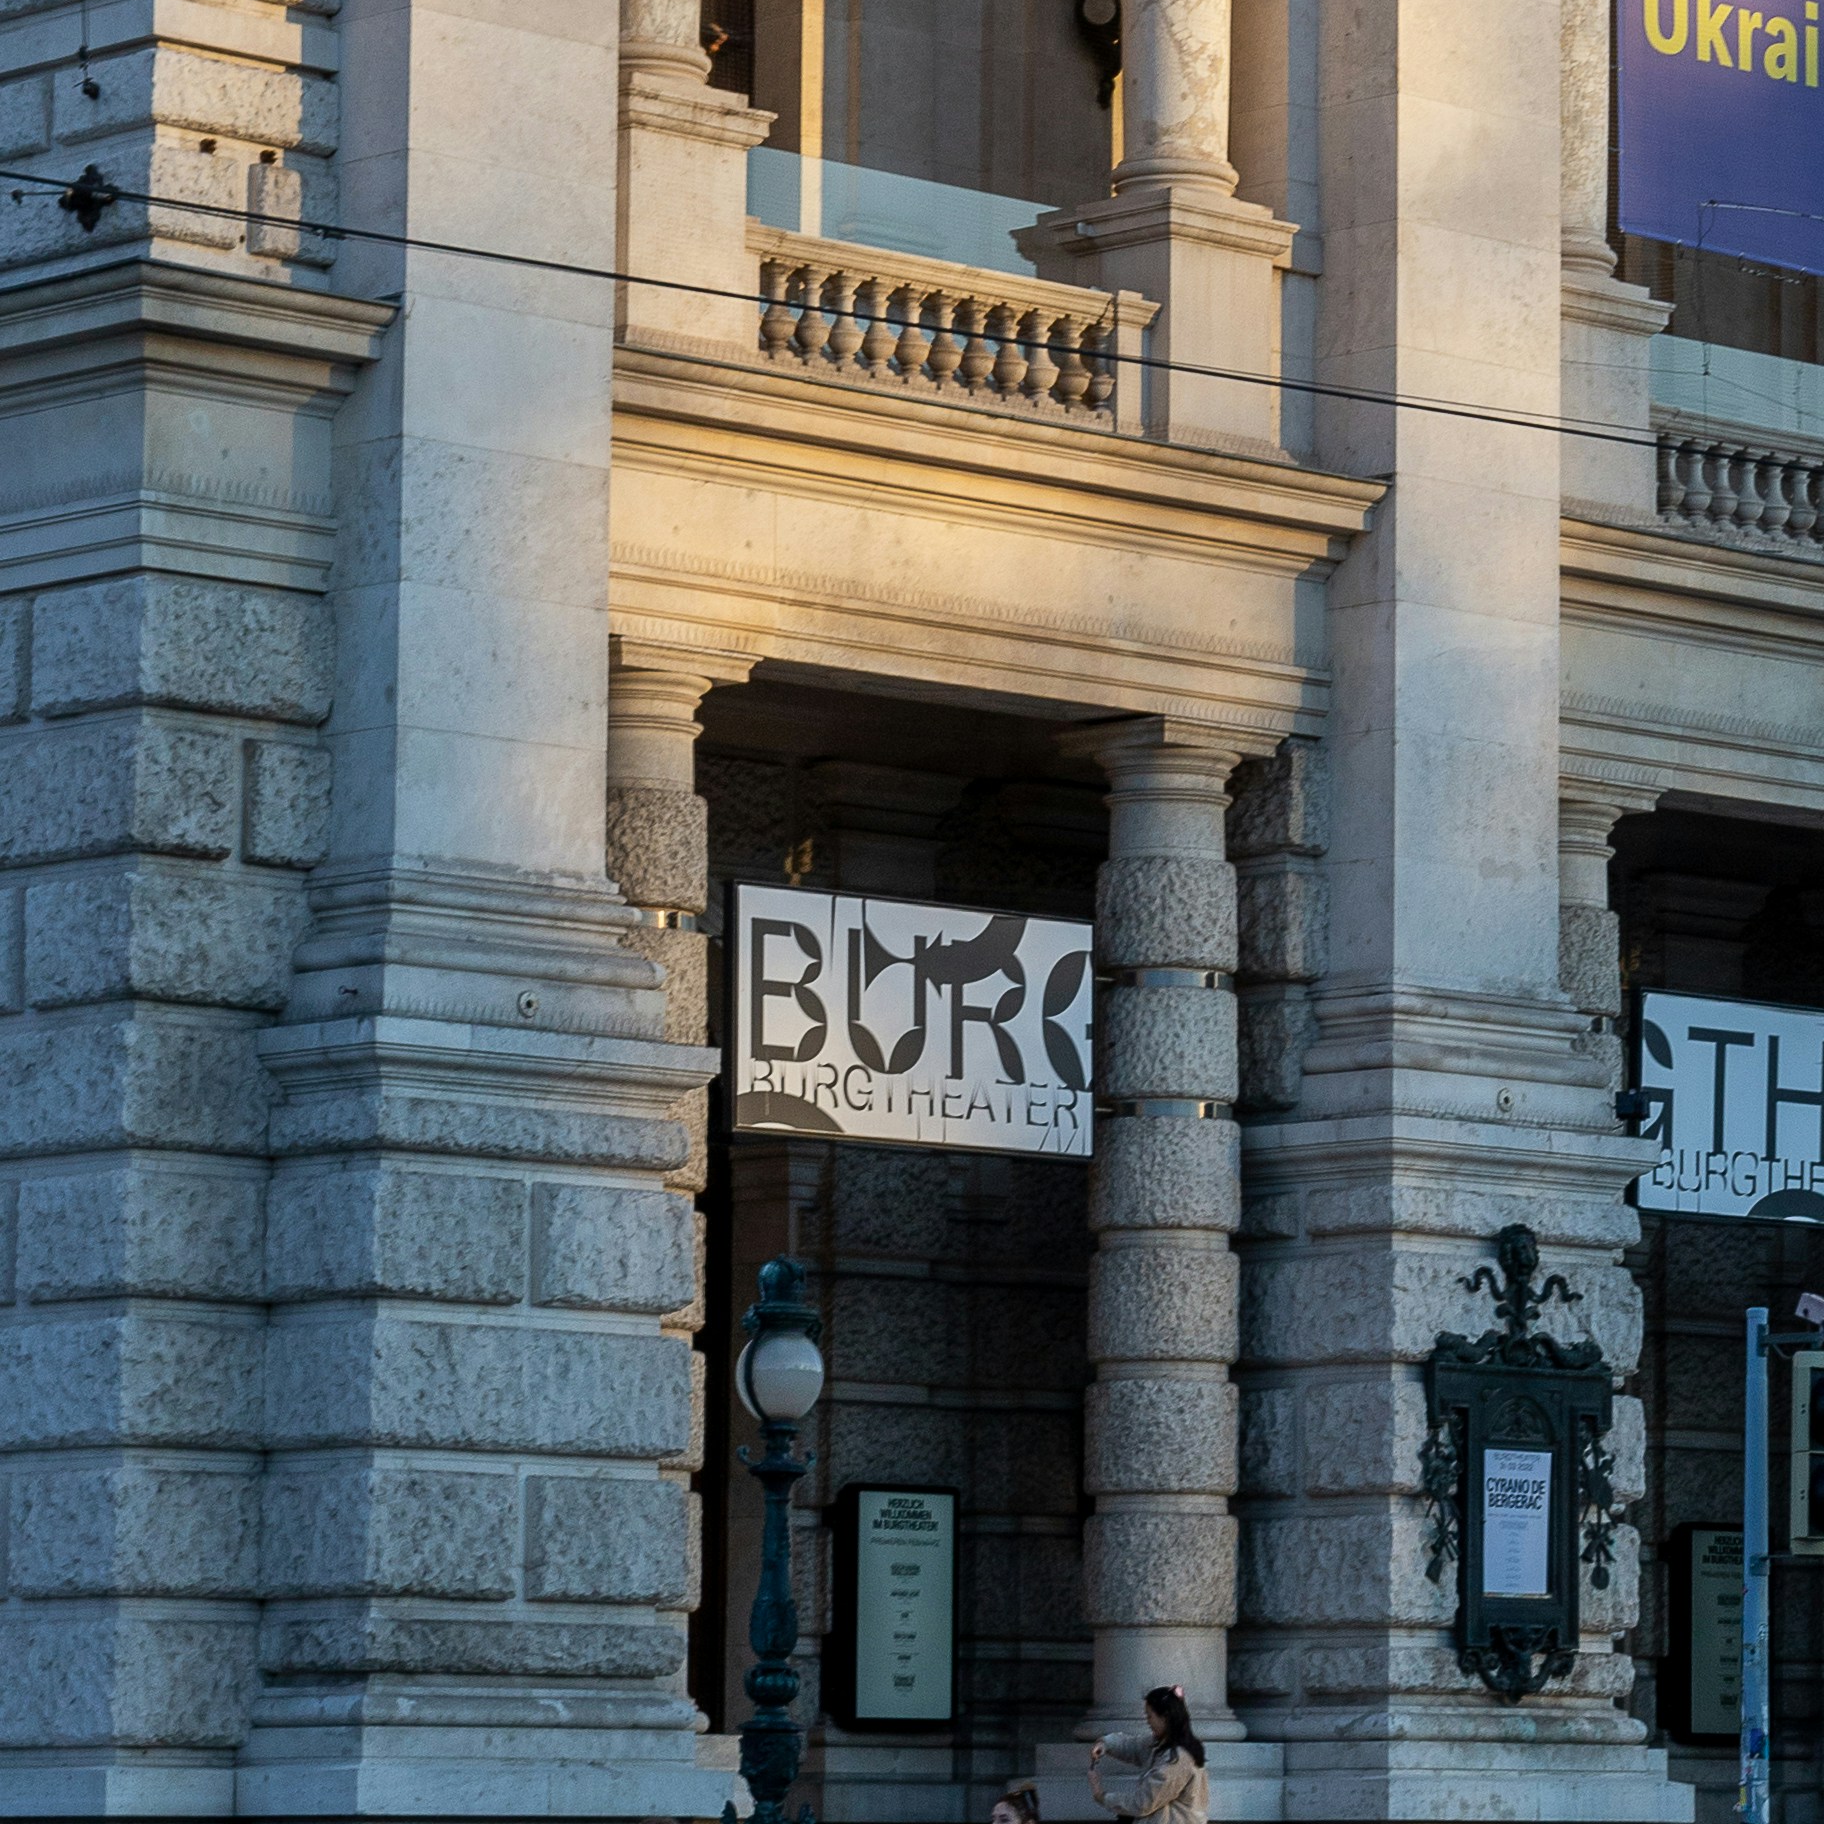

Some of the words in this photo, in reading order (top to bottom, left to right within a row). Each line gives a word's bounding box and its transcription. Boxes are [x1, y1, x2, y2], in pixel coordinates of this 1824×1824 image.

[750, 1059, 1079, 1130] BURGTHEATER
[1486, 1476, 1530, 1494] CYRANO
[1531, 1479, 1547, 1495] DE
[1488, 1492, 1543, 1510] BERGERAC
